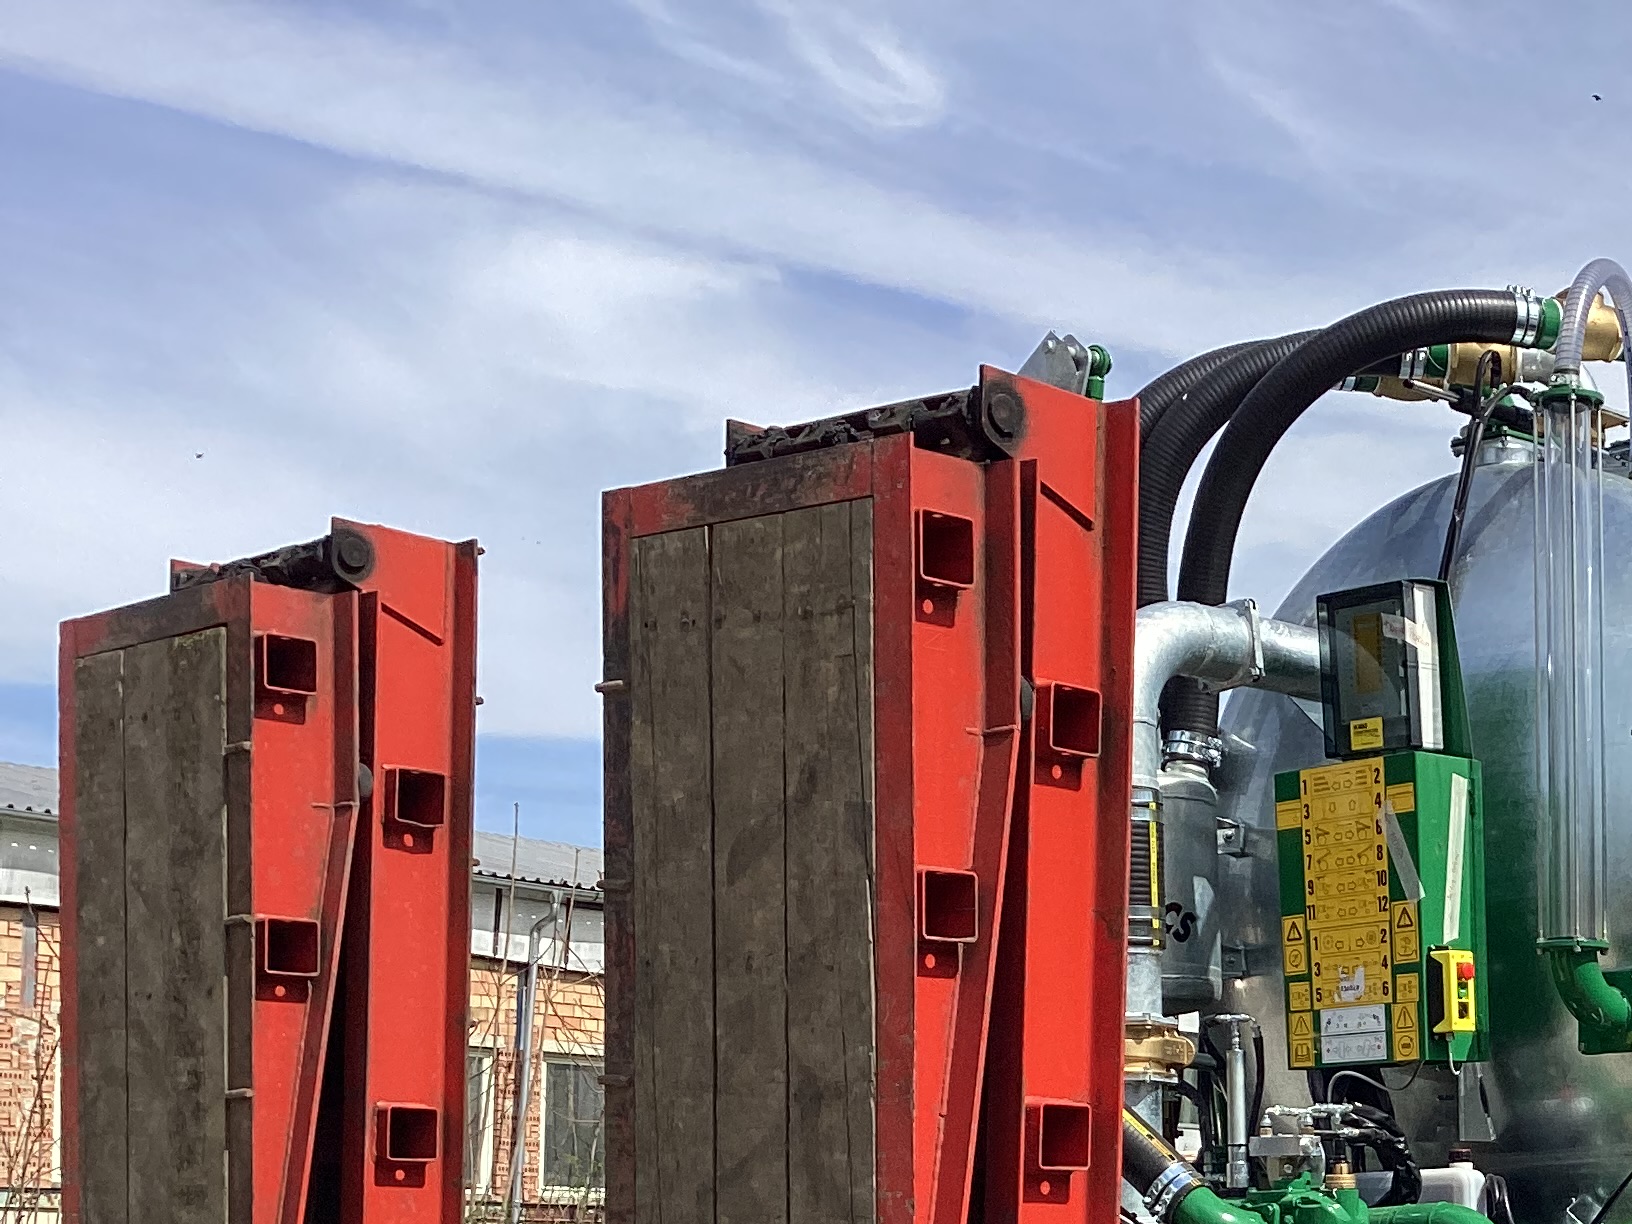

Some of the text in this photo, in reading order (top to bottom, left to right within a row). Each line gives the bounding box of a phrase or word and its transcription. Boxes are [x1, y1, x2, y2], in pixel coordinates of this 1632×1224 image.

[1302, 768, 1381, 795] 1 2
[1303, 792, 1382, 819] 3 4
[1305, 819, 1382, 845] 5 6
[1306, 854, 1312, 870] 7
[1376, 845, 1383, 860] 8
[1308, 870, 1387, 895] 9 10
[1307, 896, 1388, 920] 11 12
[1313, 929, 1387, 951] 1 2
[1314, 955, 1388, 977] 3 4
[1315, 981, 1389, 1002] 5 6
